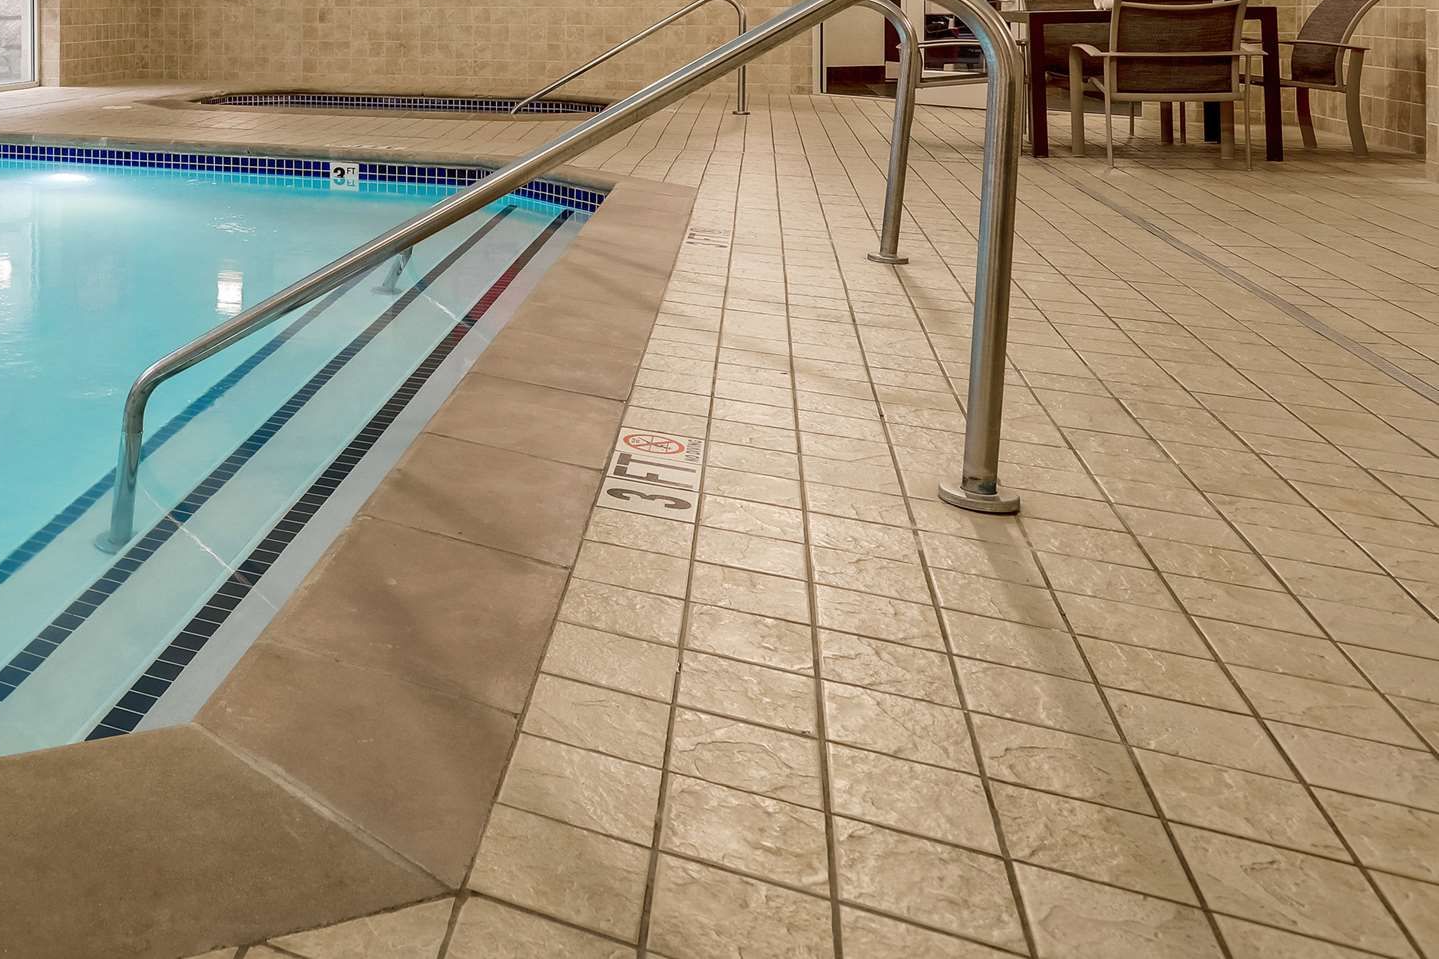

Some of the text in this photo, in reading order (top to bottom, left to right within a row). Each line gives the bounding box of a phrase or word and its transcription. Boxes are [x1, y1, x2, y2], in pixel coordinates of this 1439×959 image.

[346, 167, 356, 175] FT
[606, 452, 697, 510] 3 FT
